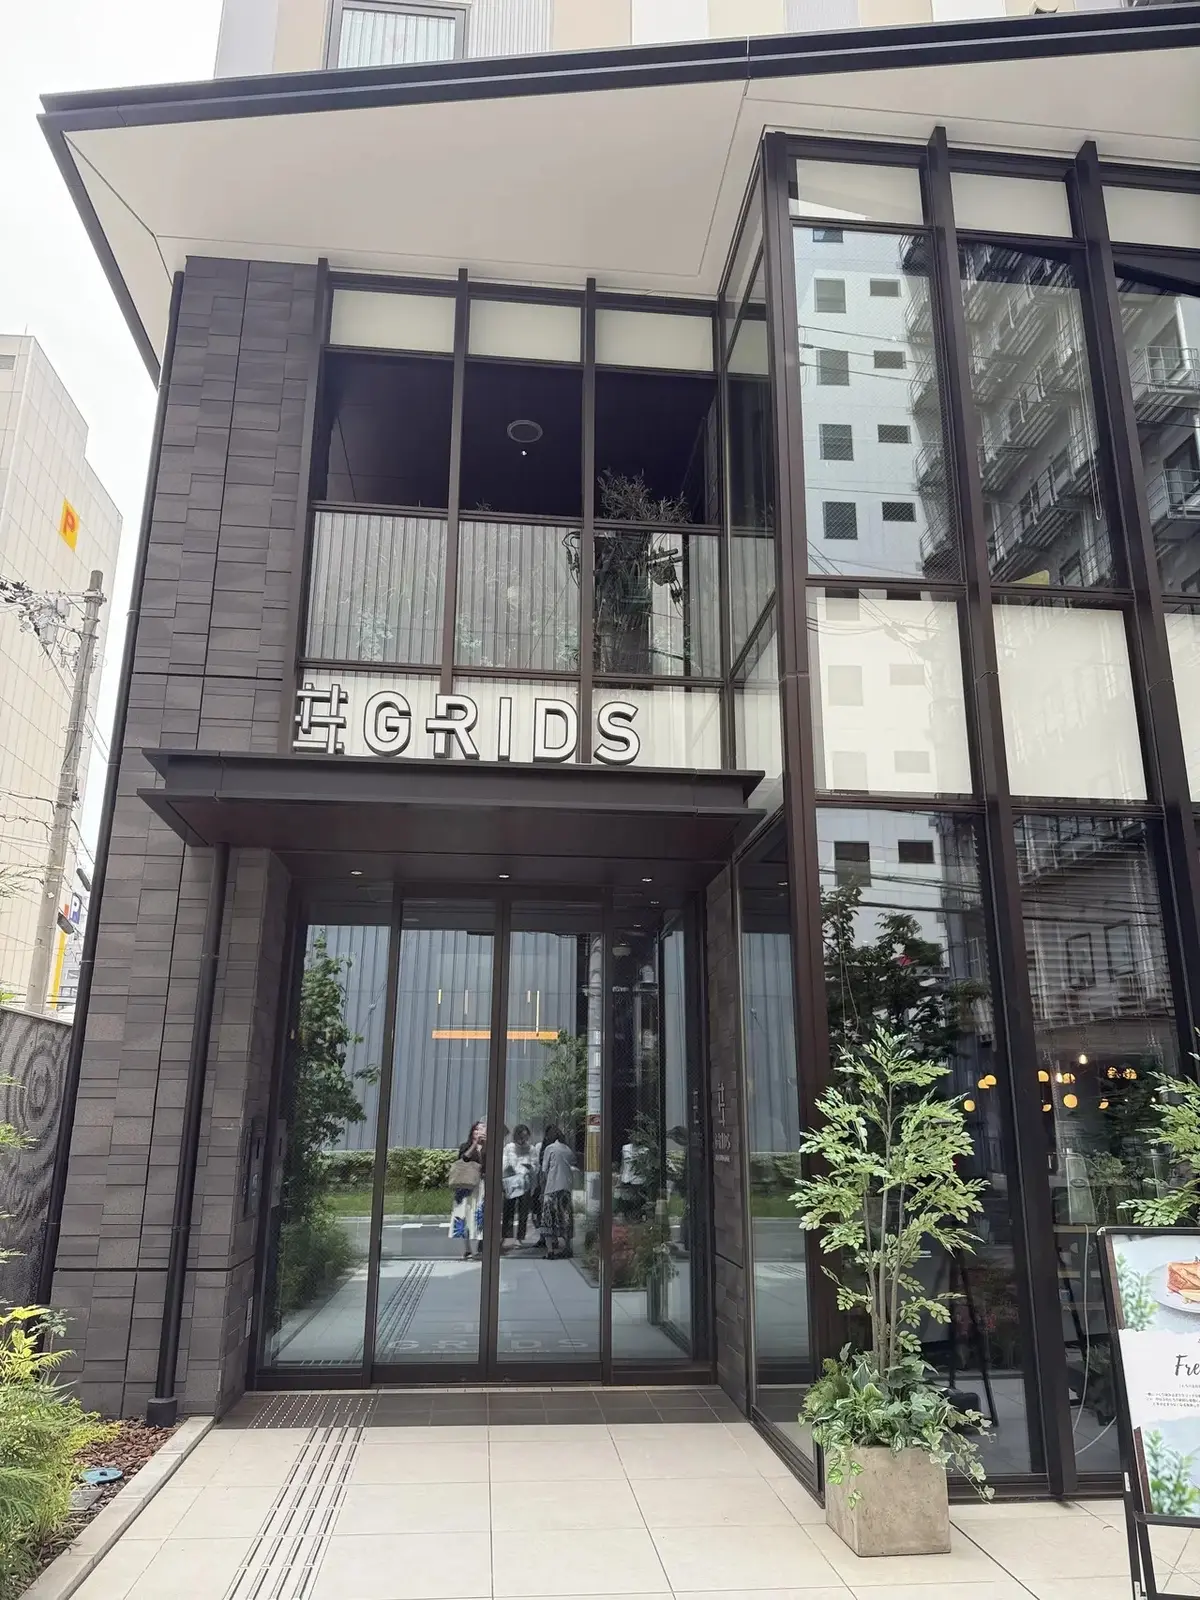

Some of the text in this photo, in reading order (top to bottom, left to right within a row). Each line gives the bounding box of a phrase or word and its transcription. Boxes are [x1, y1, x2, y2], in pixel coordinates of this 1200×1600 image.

[62, 504, 76, 536] P
[363, 690, 641, 766] GRIDS
[70, 894, 80, 919] P
[387, 1338, 589, 1350] GRDS
